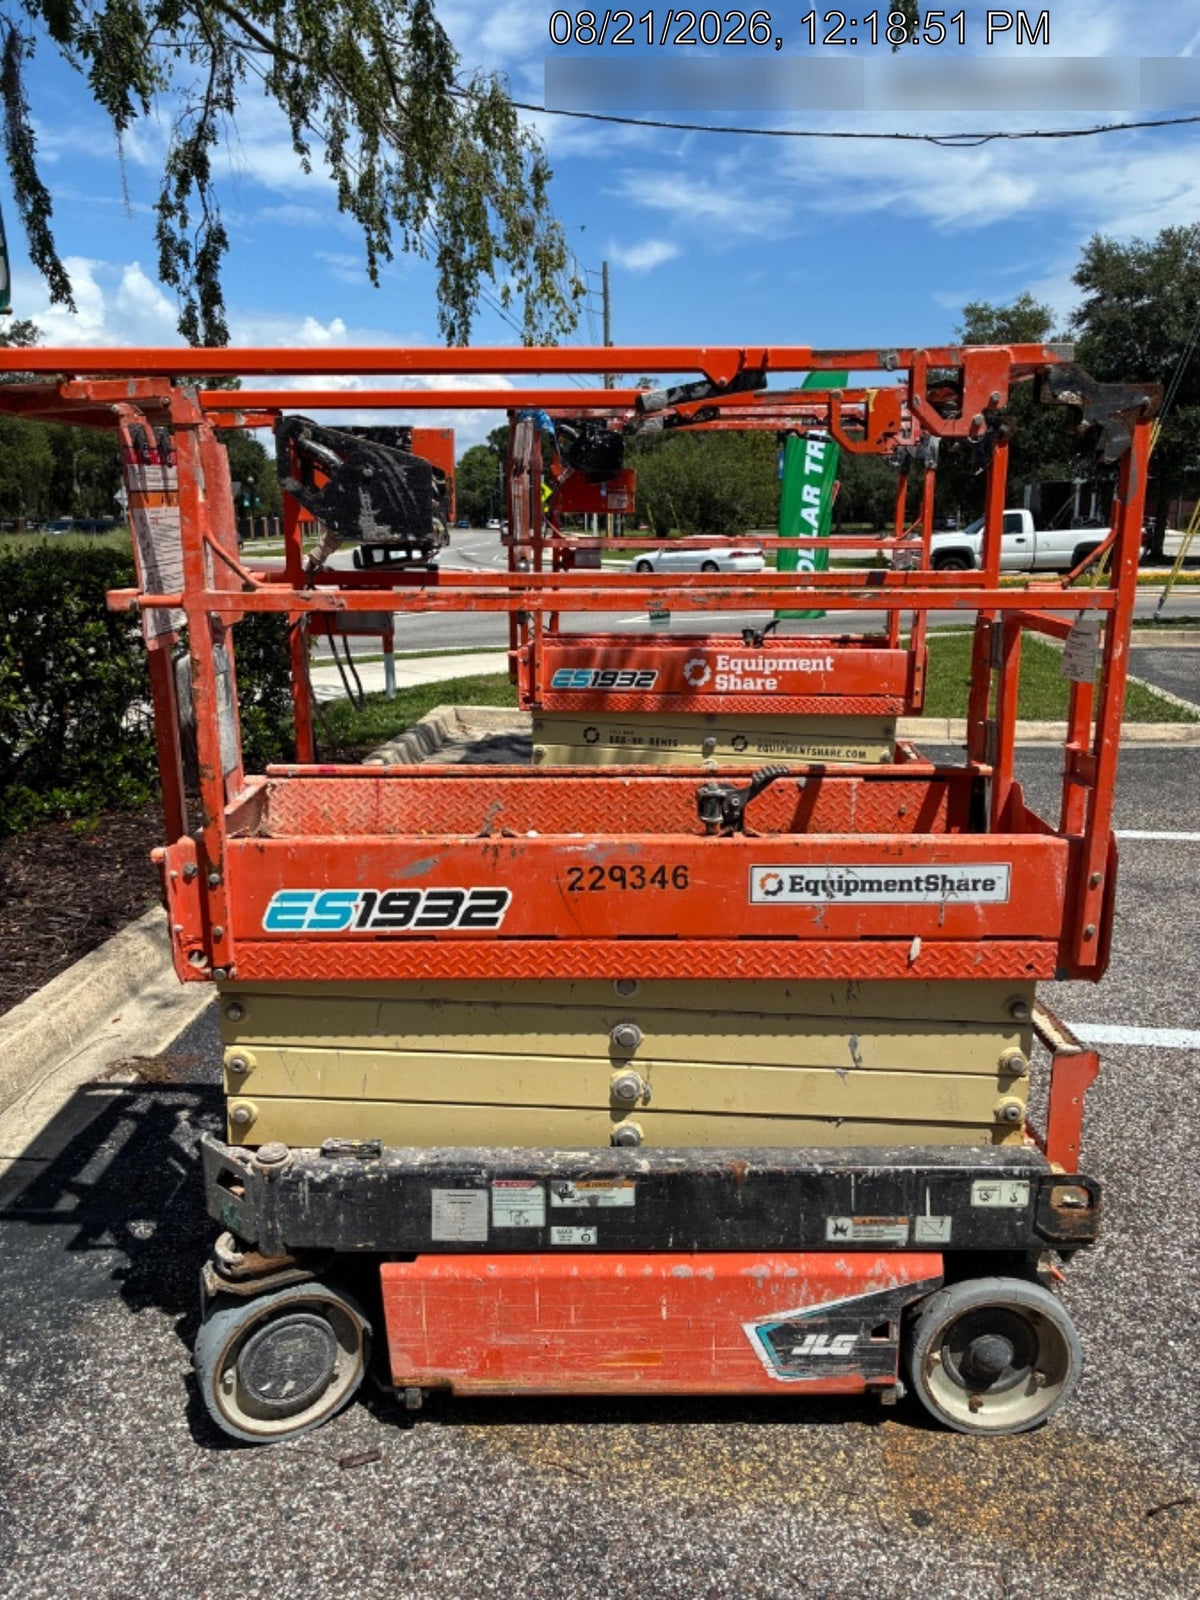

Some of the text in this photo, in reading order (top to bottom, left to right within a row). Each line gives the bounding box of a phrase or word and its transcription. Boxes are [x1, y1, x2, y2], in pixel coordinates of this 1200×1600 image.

[715, 655, 834, 675] Equipment
[552, 670, 656, 687] ES1932
[715, 674, 777, 691] Share
[567, 865, 689, 892] 229346
[789, 874, 995, 899] EquipmentShare
[266, 890, 509, 929] ES1932
[791, 1334, 858, 1355] JLG
